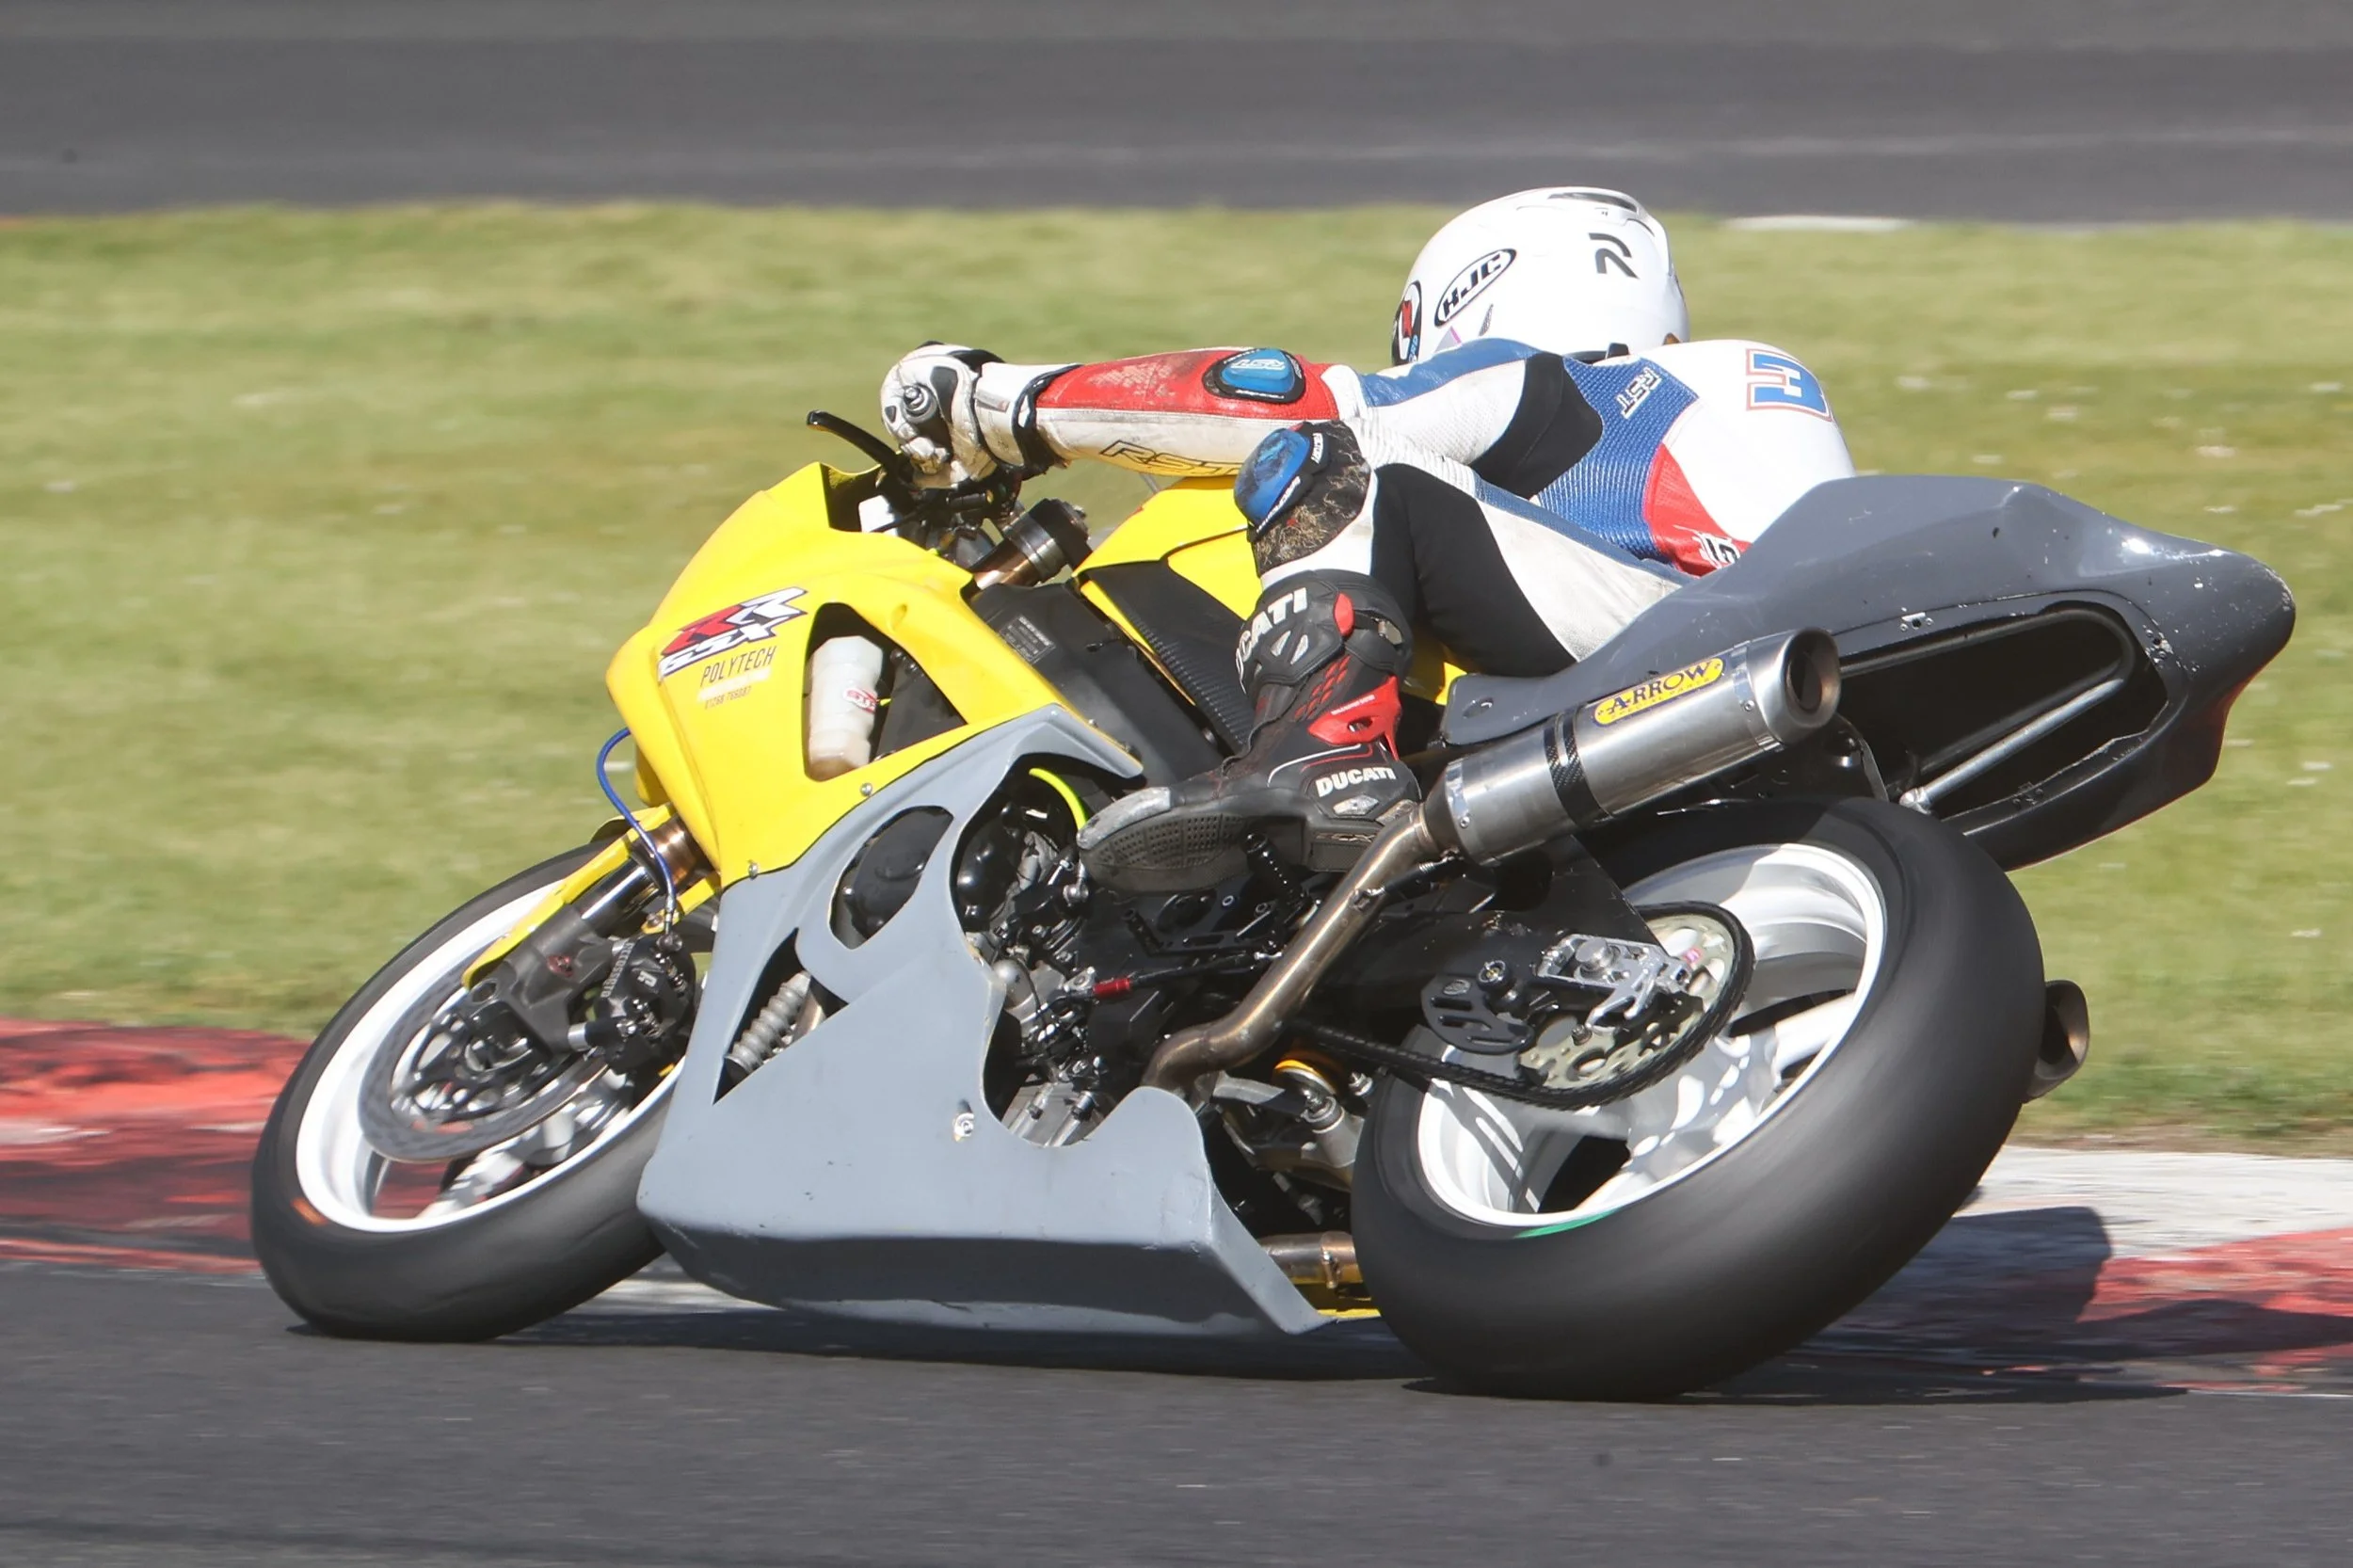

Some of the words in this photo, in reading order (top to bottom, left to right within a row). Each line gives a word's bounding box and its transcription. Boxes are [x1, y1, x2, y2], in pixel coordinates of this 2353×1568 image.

[1442, 252, 1502, 319] HJC
[1616, 366, 1663, 420] RST
[700, 646, 777, 687] POLYTECH
[1608, 660, 1713, 715] ARROW
[1315, 766, 1397, 797] DUCATI
